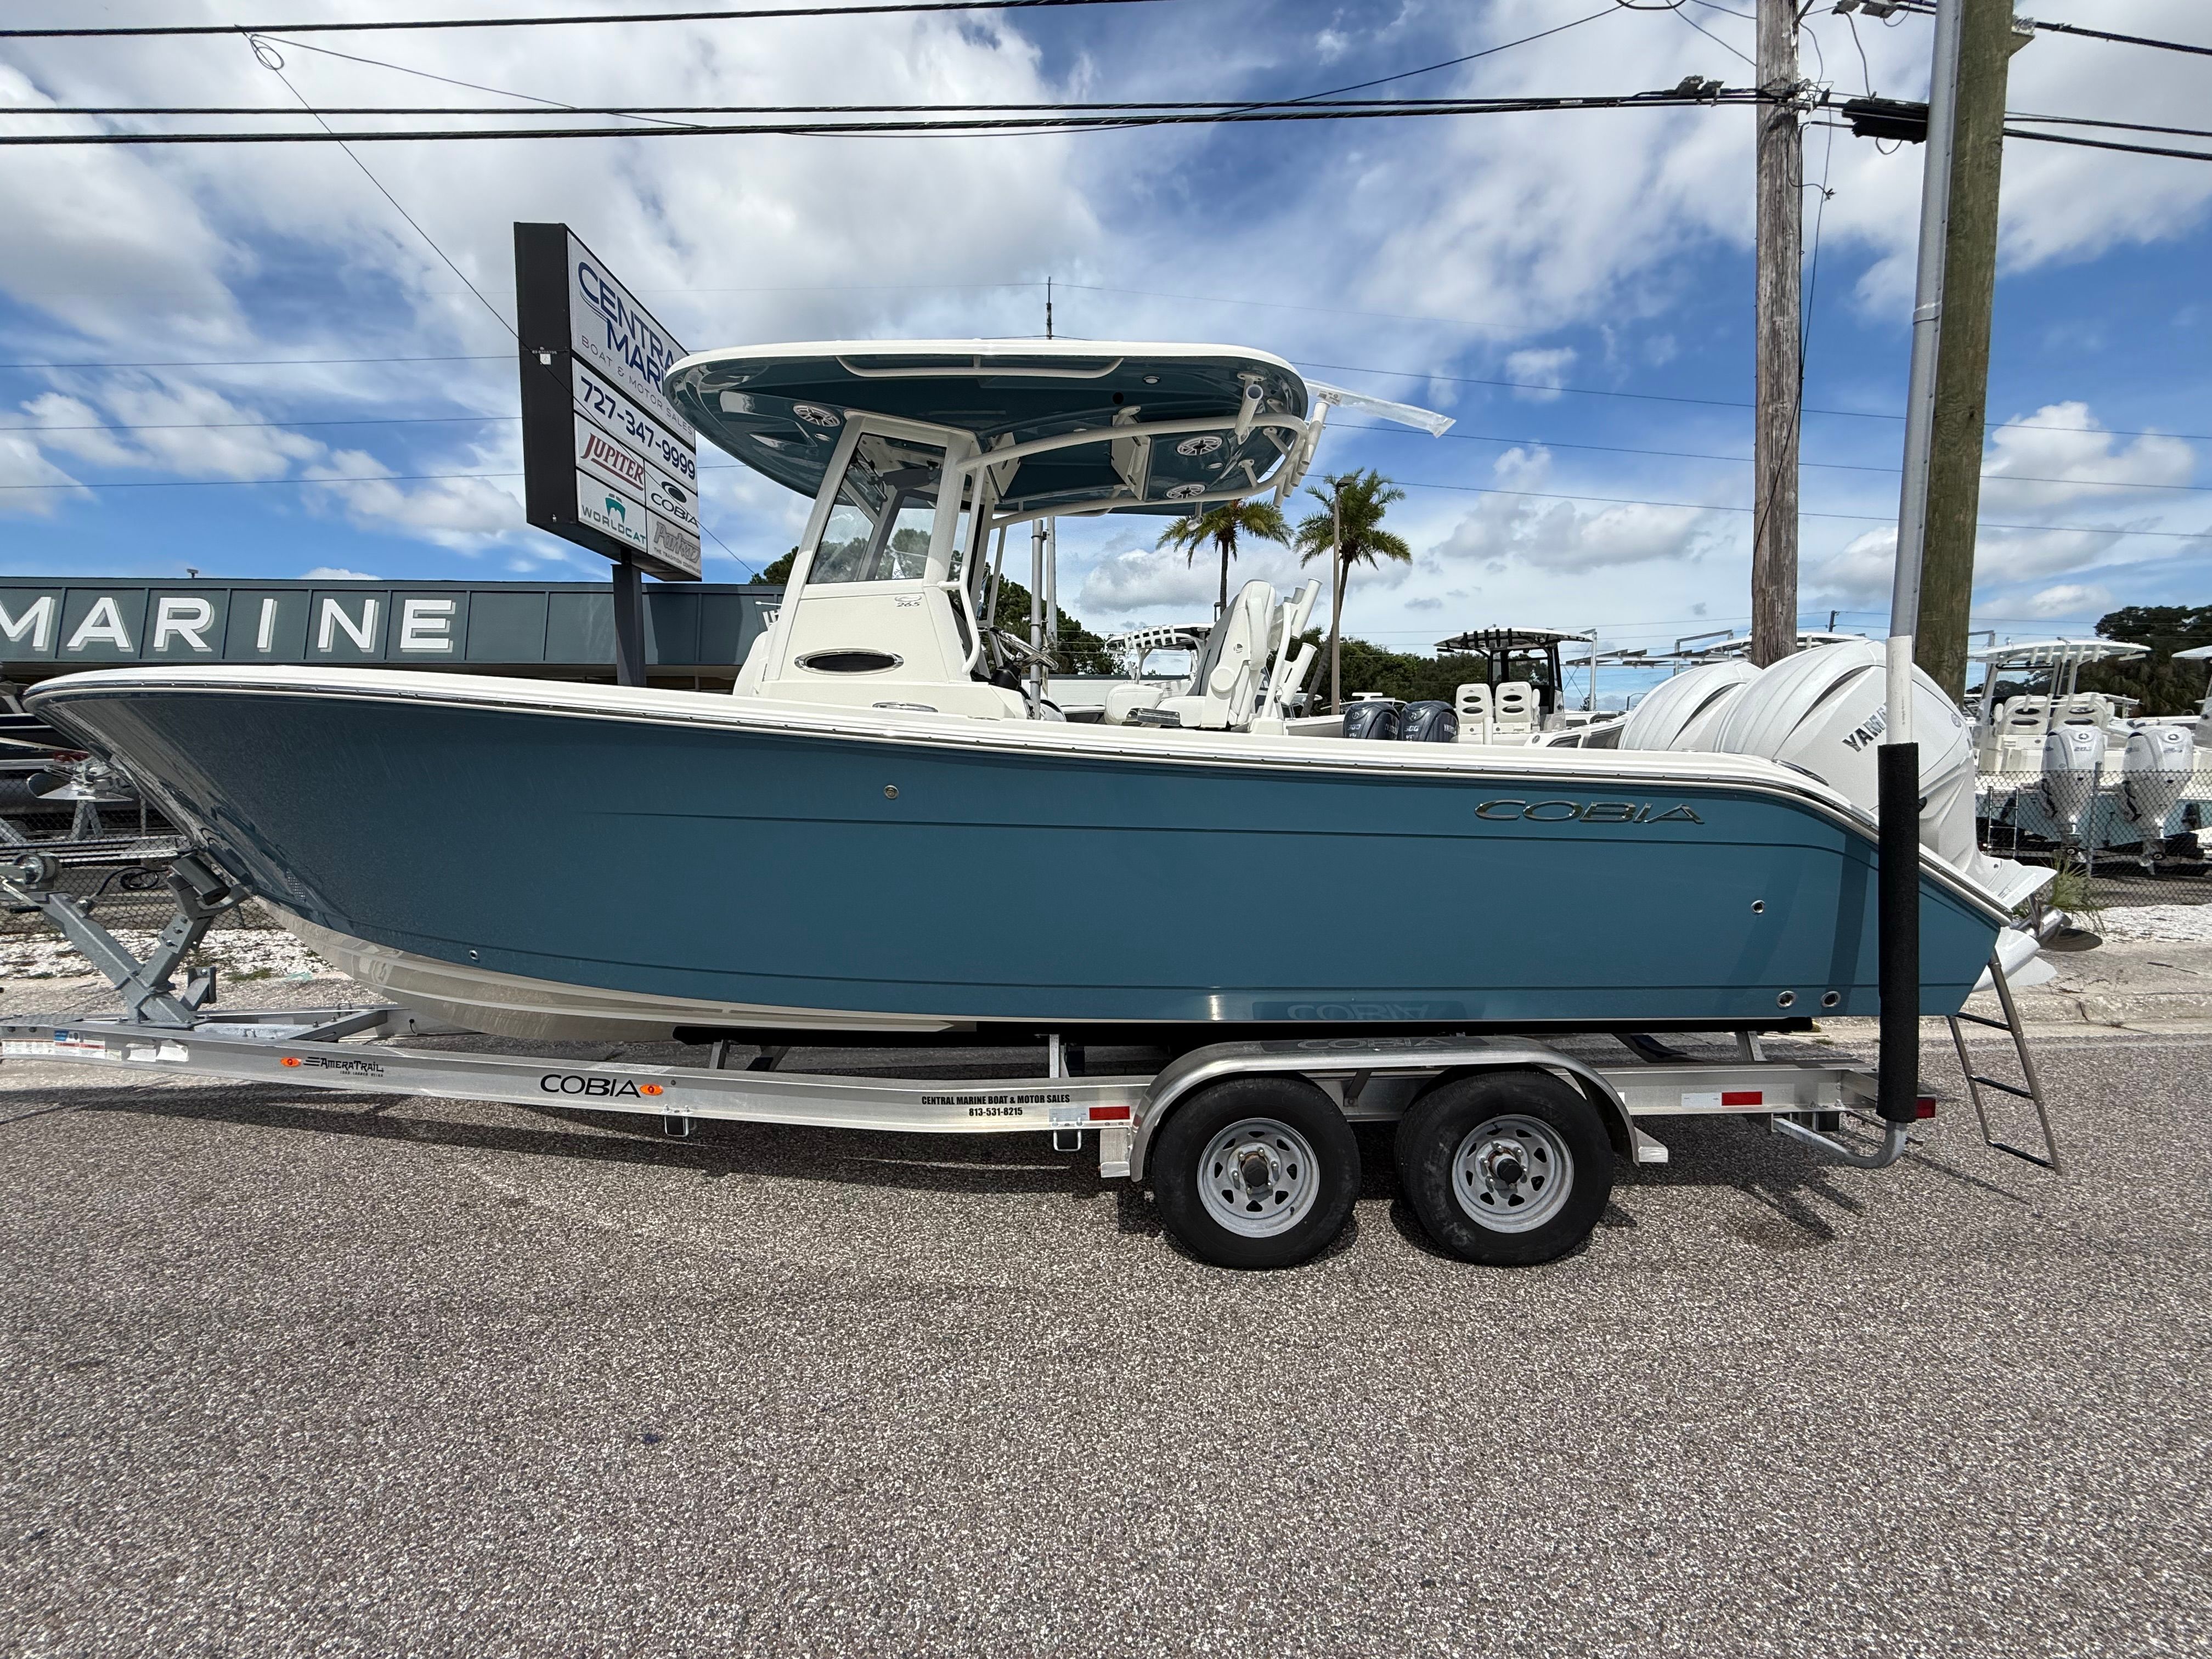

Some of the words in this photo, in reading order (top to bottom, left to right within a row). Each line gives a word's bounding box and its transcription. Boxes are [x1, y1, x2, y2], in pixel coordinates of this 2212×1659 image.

[578, 262, 674, 371] CENTRA
[607, 318, 665, 397] MARI
[582, 335, 612, 366] BOAT
[618, 366, 624, 376] &
[629, 376, 662, 408] MOTOR
[667, 408, 692, 435] SALES
[581, 375, 695, 480] 727-347-9999
[580, 432, 644, 485] JUPITER
[582, 505, 646, 544] WORLDCAT
[651, 493, 699, 528] COBIA
[0, 597, 455, 652] MARINE
[1474, 799, 1705, 824] COBIA
[540, 1074, 641, 1098] COBIA
[922, 1096, 955, 1105] CENTRAL
[957, 1096, 986, 1105] MARINE
[988, 1095, 1008, 1104] BOAT
[1009, 1096, 1015, 1104] &
[1017, 1094, 1045, 1104] MOTOR
[1047, 1094, 1070, 1103] SALES
[969, 1107, 1023, 1116] 813-531-8215
